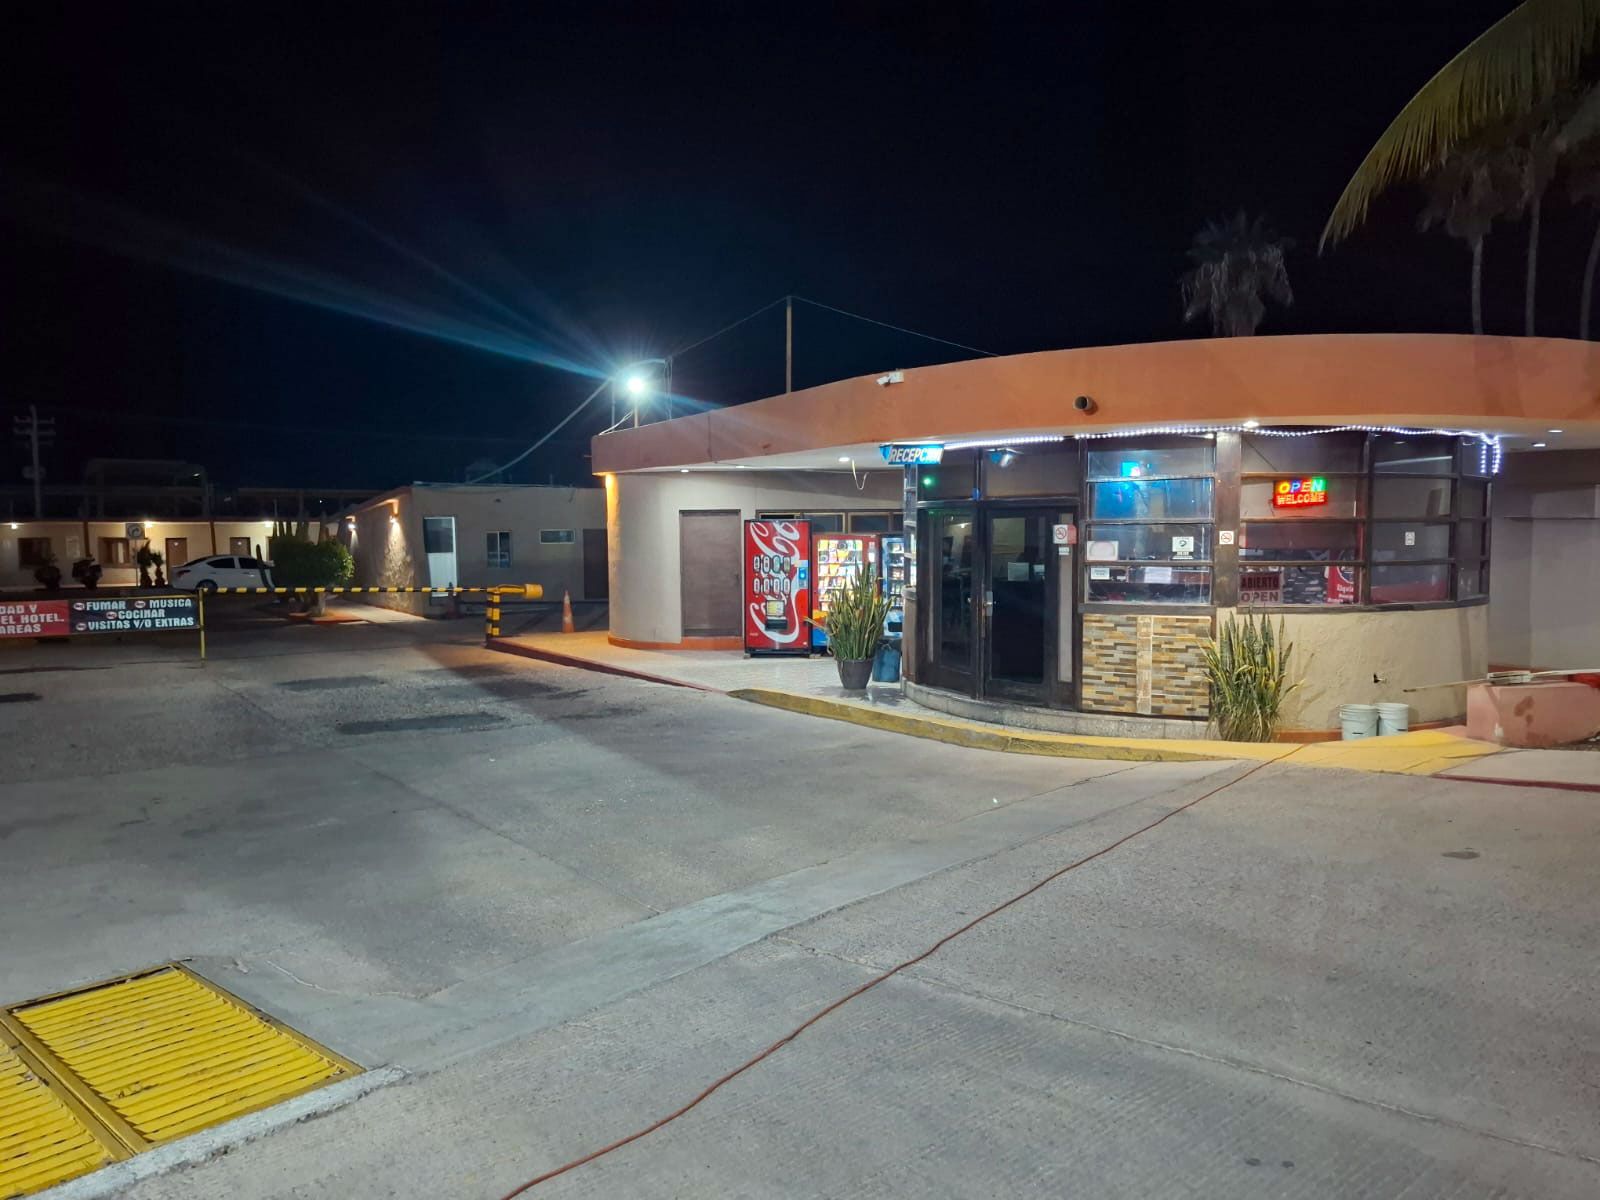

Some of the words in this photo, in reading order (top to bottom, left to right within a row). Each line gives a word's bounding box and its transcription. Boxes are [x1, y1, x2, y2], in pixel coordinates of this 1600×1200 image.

[1278, 479, 1325, 494] OPEN
[1276, 492, 1325, 505] WELCOME
[1241, 576, 1279, 590] ABIERTO
[1241, 591, 1279, 602] OPEN
[86, 601, 126, 611] FUMAR
[149, 599, 192, 609] MUSICA
[118, 609, 165, 620] COCINAR
[88, 619, 130, 631] VISITAS
[134, 619, 152, 629] Y/O
[155, 617, 194, 627] EXTRAS
